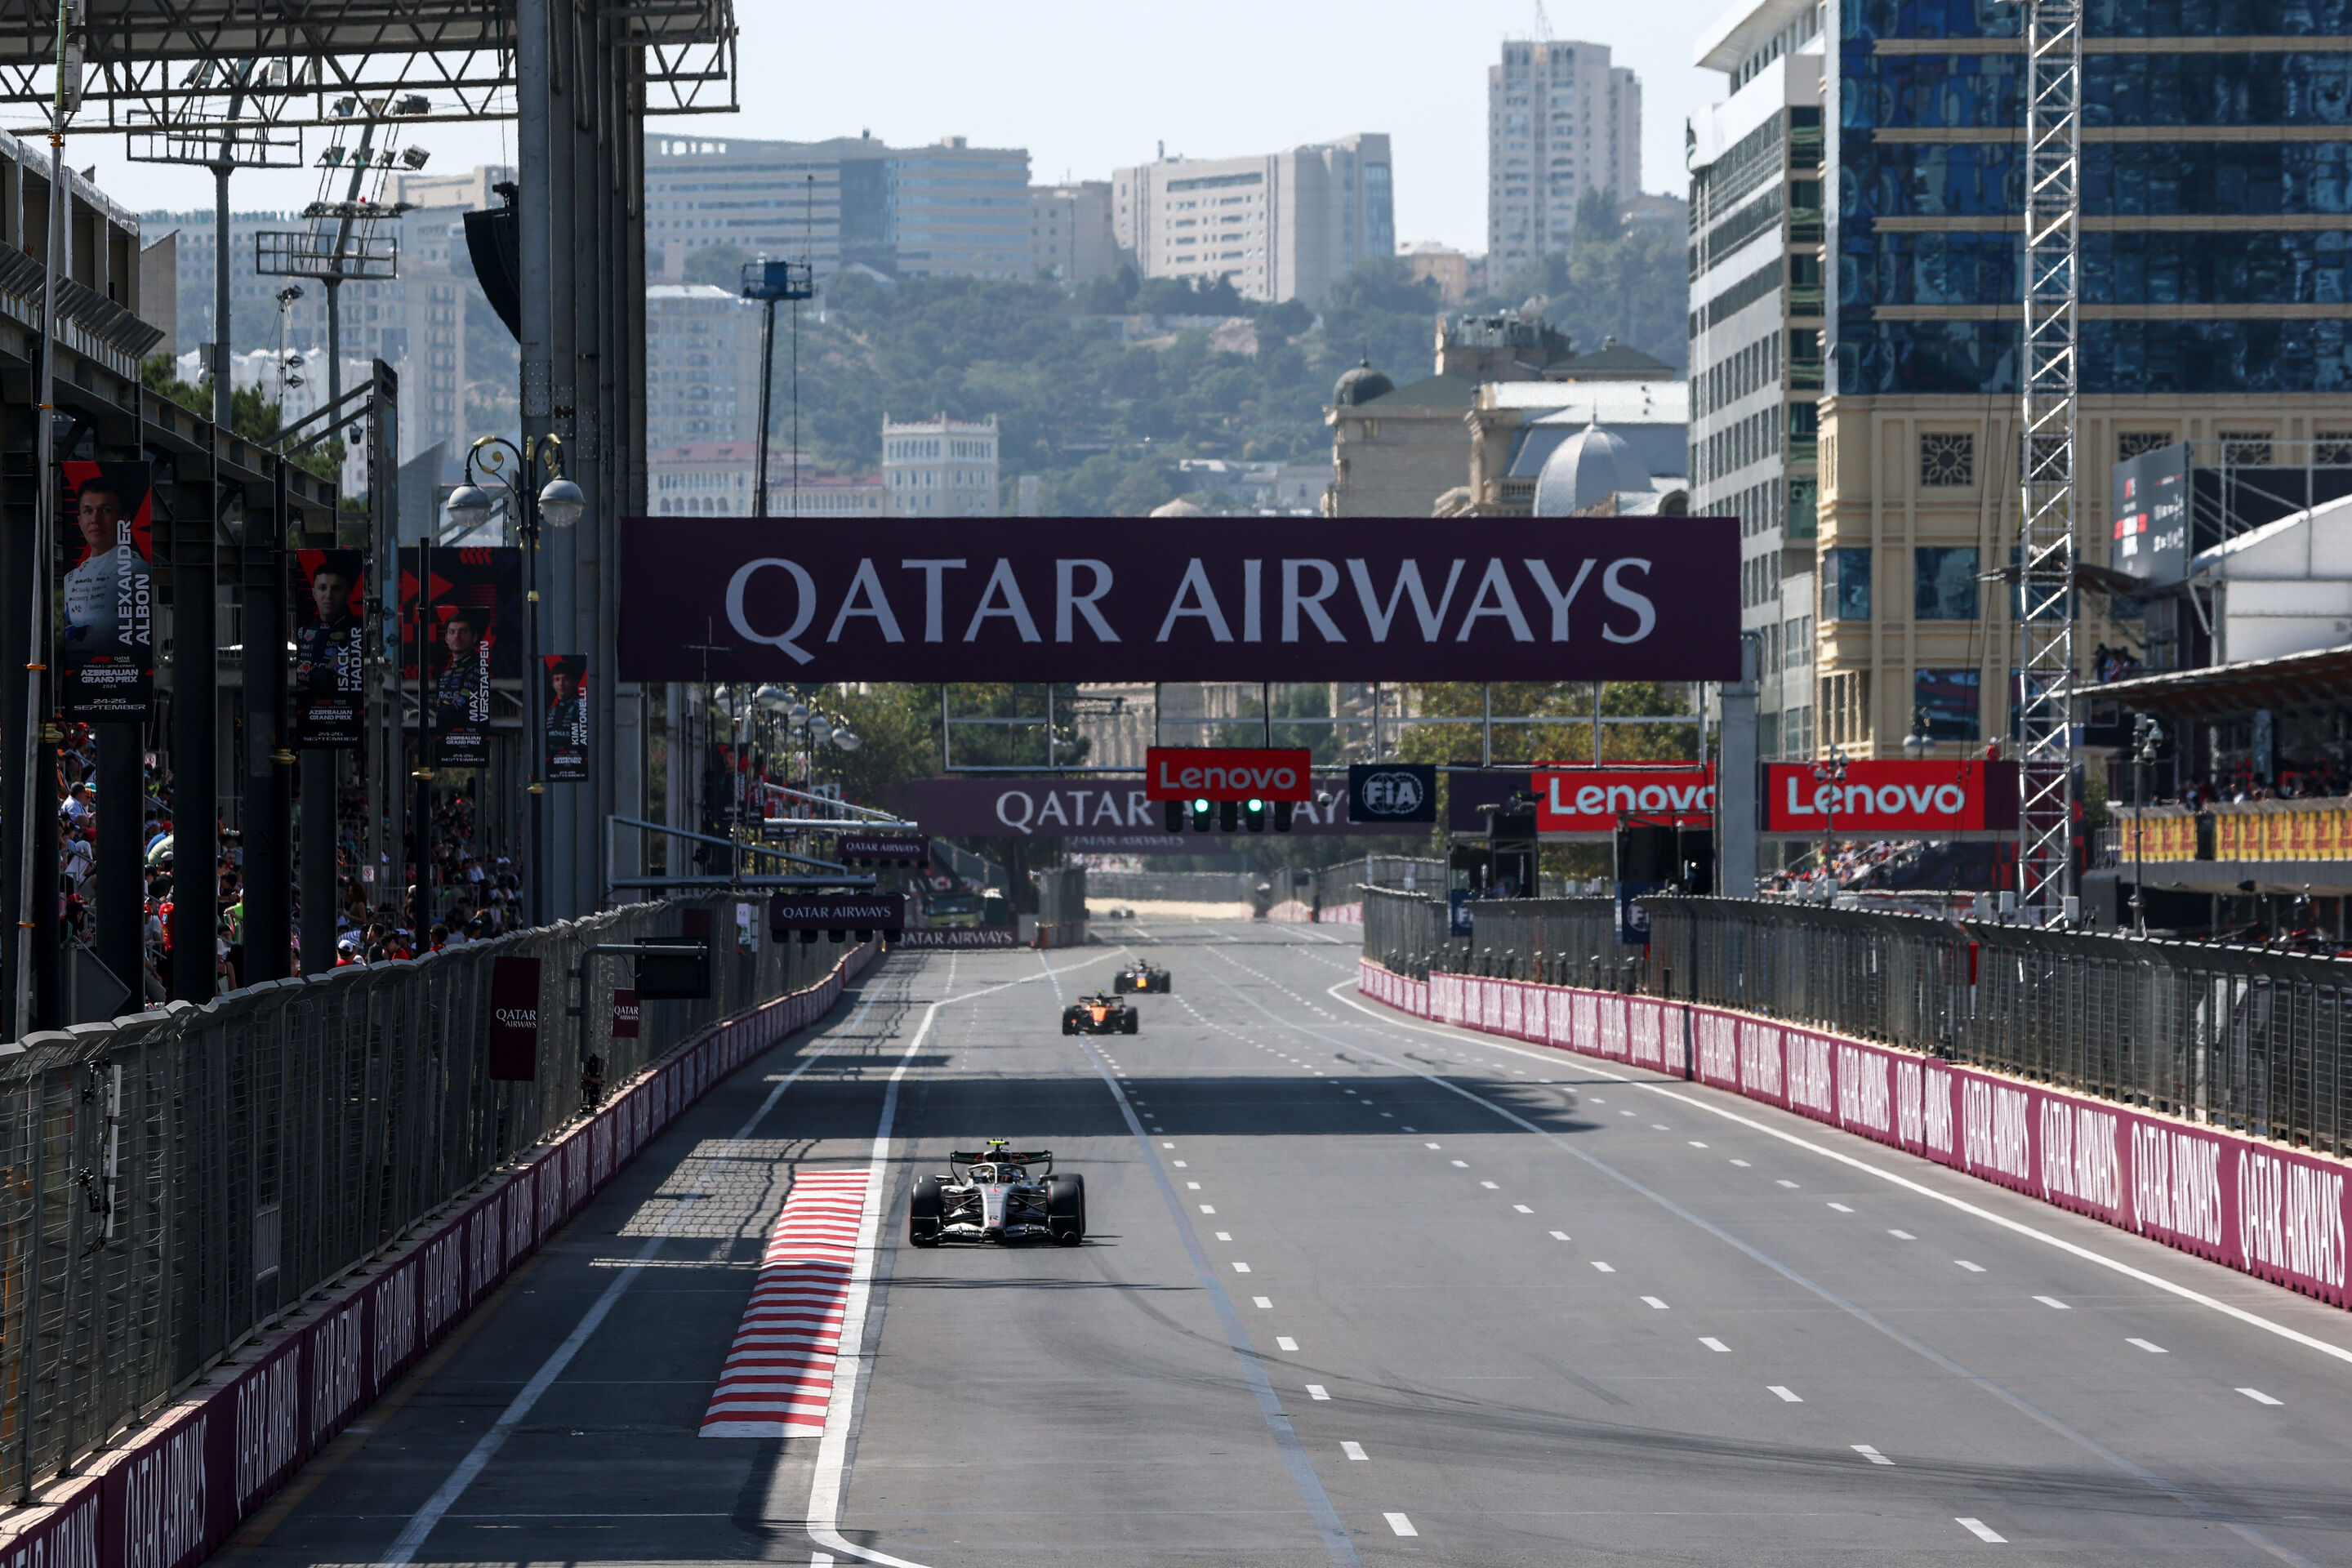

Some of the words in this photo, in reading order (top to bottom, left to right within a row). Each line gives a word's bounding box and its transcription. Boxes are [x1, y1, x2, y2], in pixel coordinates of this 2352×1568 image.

[118, 520, 132, 645] ALEXANDER
[136, 573, 150, 645] ALBON
[725, 557, 1122, 665] QATAR
[1156, 558, 1656, 644] AIRWAYS
[338, 646, 349, 692] ISACK
[350, 627, 362, 692] HADJAR
[479, 641, 489, 721] VERSTAPPEN
[469, 691, 479, 721] MAX
[579, 687, 588, 745] ANTONELLI
[1159, 761, 1297, 790] Lenovo
[1787, 776, 1965, 815] Lenovo
[996, 790, 1156, 835] QATAR
[846, 842, 878, 852] QATAR
[881, 844, 920, 853] AIRWAYS
[782, 906, 830, 920] QATAR
[831, 906, 891, 918] AIRWAYS
[947, 931, 1013, 945] AIRWAYS
[496, 1009, 537, 1022] QATAR
[505, 1021, 537, 1029] AIRWAYS
[614, 1005, 639, 1016] QATAR
[2040, 1098, 2074, 1200] QATAR
[2075, 1106, 2118, 1210] AIRWAYS
[2132, 1121, 2170, 1233] QATAR
[2170, 1132, 2221, 1246] AIRWAYS
[2238, 1148, 2284, 1270] QATAR
[2285, 1161, 2345, 1288] AIRWAYS
[236, 1370, 266, 1521] QATAR
[265, 1343, 300, 1482] AIRWAYS
[125, 1448, 163, 1568] QATAR
[163, 1414, 207, 1568] AIRWAYS
